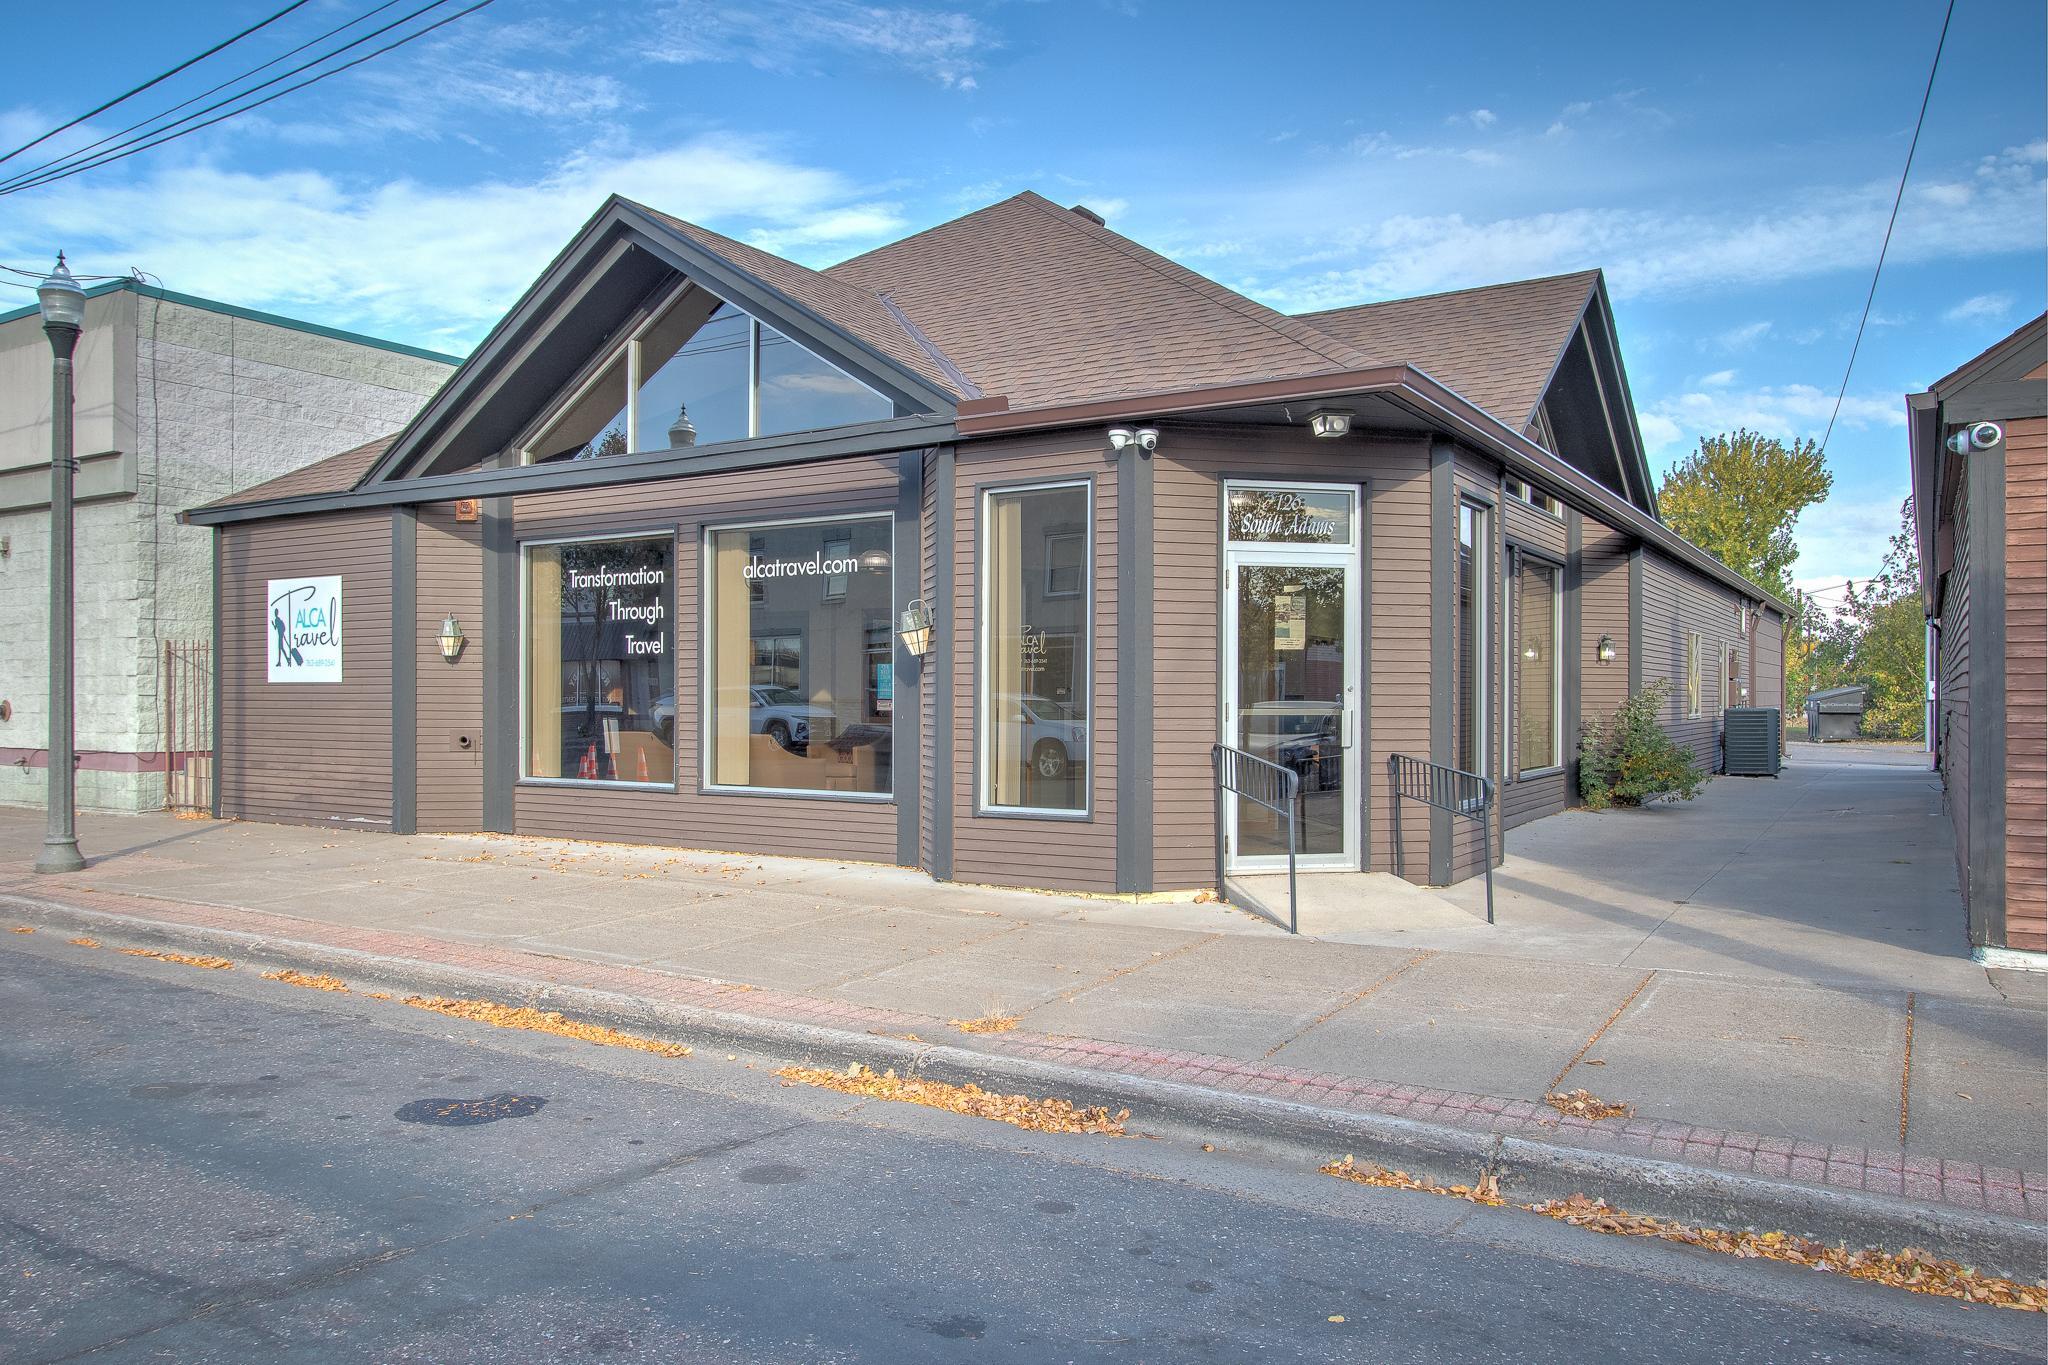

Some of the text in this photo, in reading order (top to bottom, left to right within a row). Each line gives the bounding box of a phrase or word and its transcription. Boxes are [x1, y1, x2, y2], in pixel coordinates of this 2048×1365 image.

[1241, 513, 1336, 536] South Adams
[569, 564, 664, 588] Transformation
[743, 550, 858, 579] alcatravel.com
[295, 607, 327, 628] ALCA
[609, 596, 664, 625] Through
[271, 586, 340, 666] Travel
[625, 631, 664, 655] Travel
